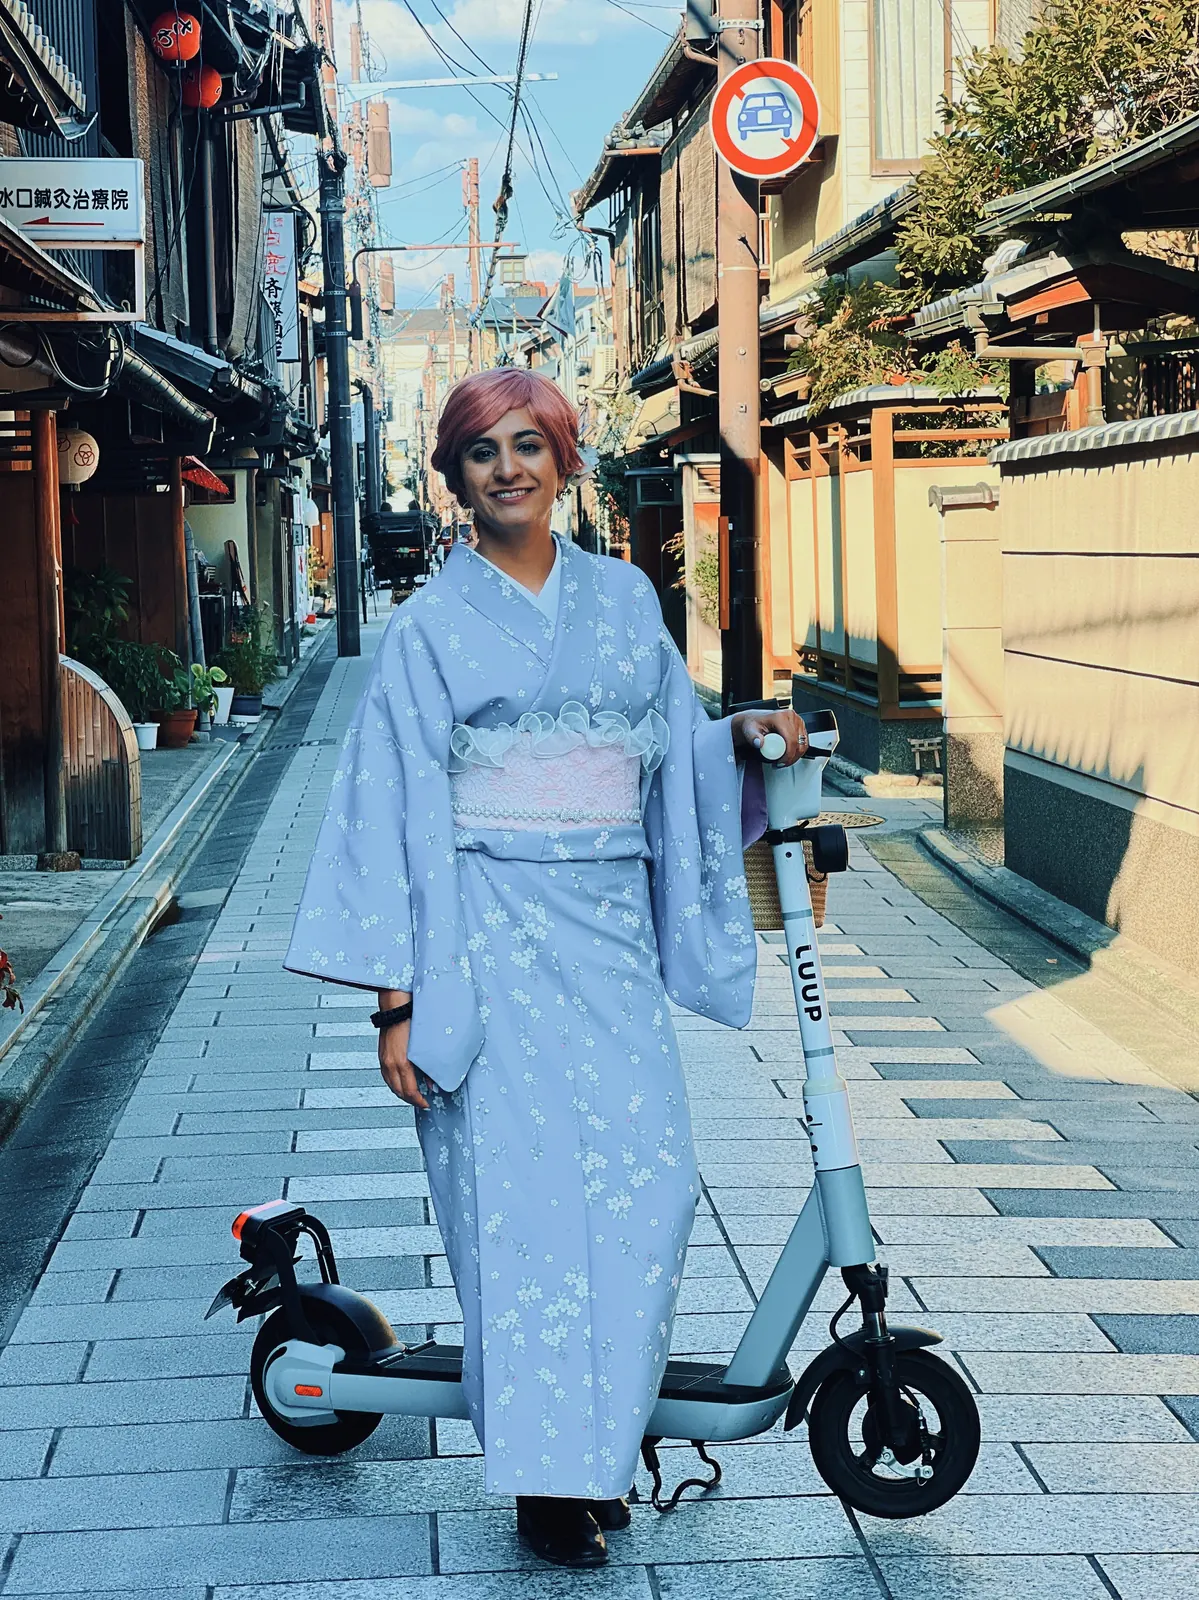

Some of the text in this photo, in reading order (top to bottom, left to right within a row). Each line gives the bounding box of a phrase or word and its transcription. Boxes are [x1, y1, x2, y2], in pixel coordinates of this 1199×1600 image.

[0, 187, 129, 210] 水口鍼灸治療院
[795, 944, 822, 1021] LUUP
